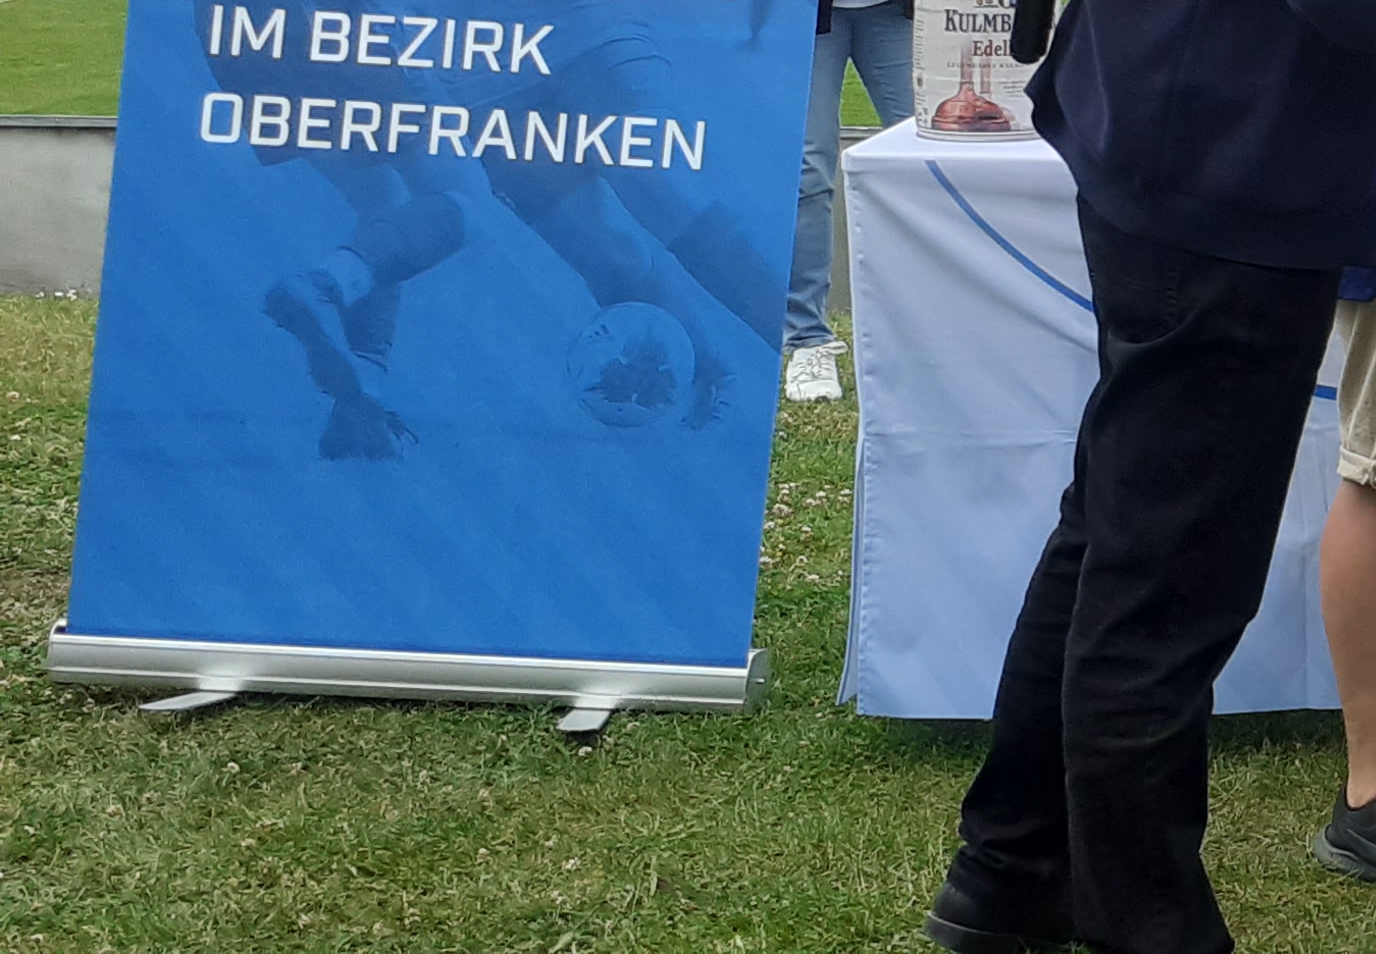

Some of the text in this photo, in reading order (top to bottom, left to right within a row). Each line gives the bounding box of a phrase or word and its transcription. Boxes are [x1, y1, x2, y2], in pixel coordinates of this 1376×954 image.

[209, 5, 554, 75] IM BEZIRK
[944, 8, 1012, 34] KULMB
[200, 91, 706, 171] OBERFRANKEN
